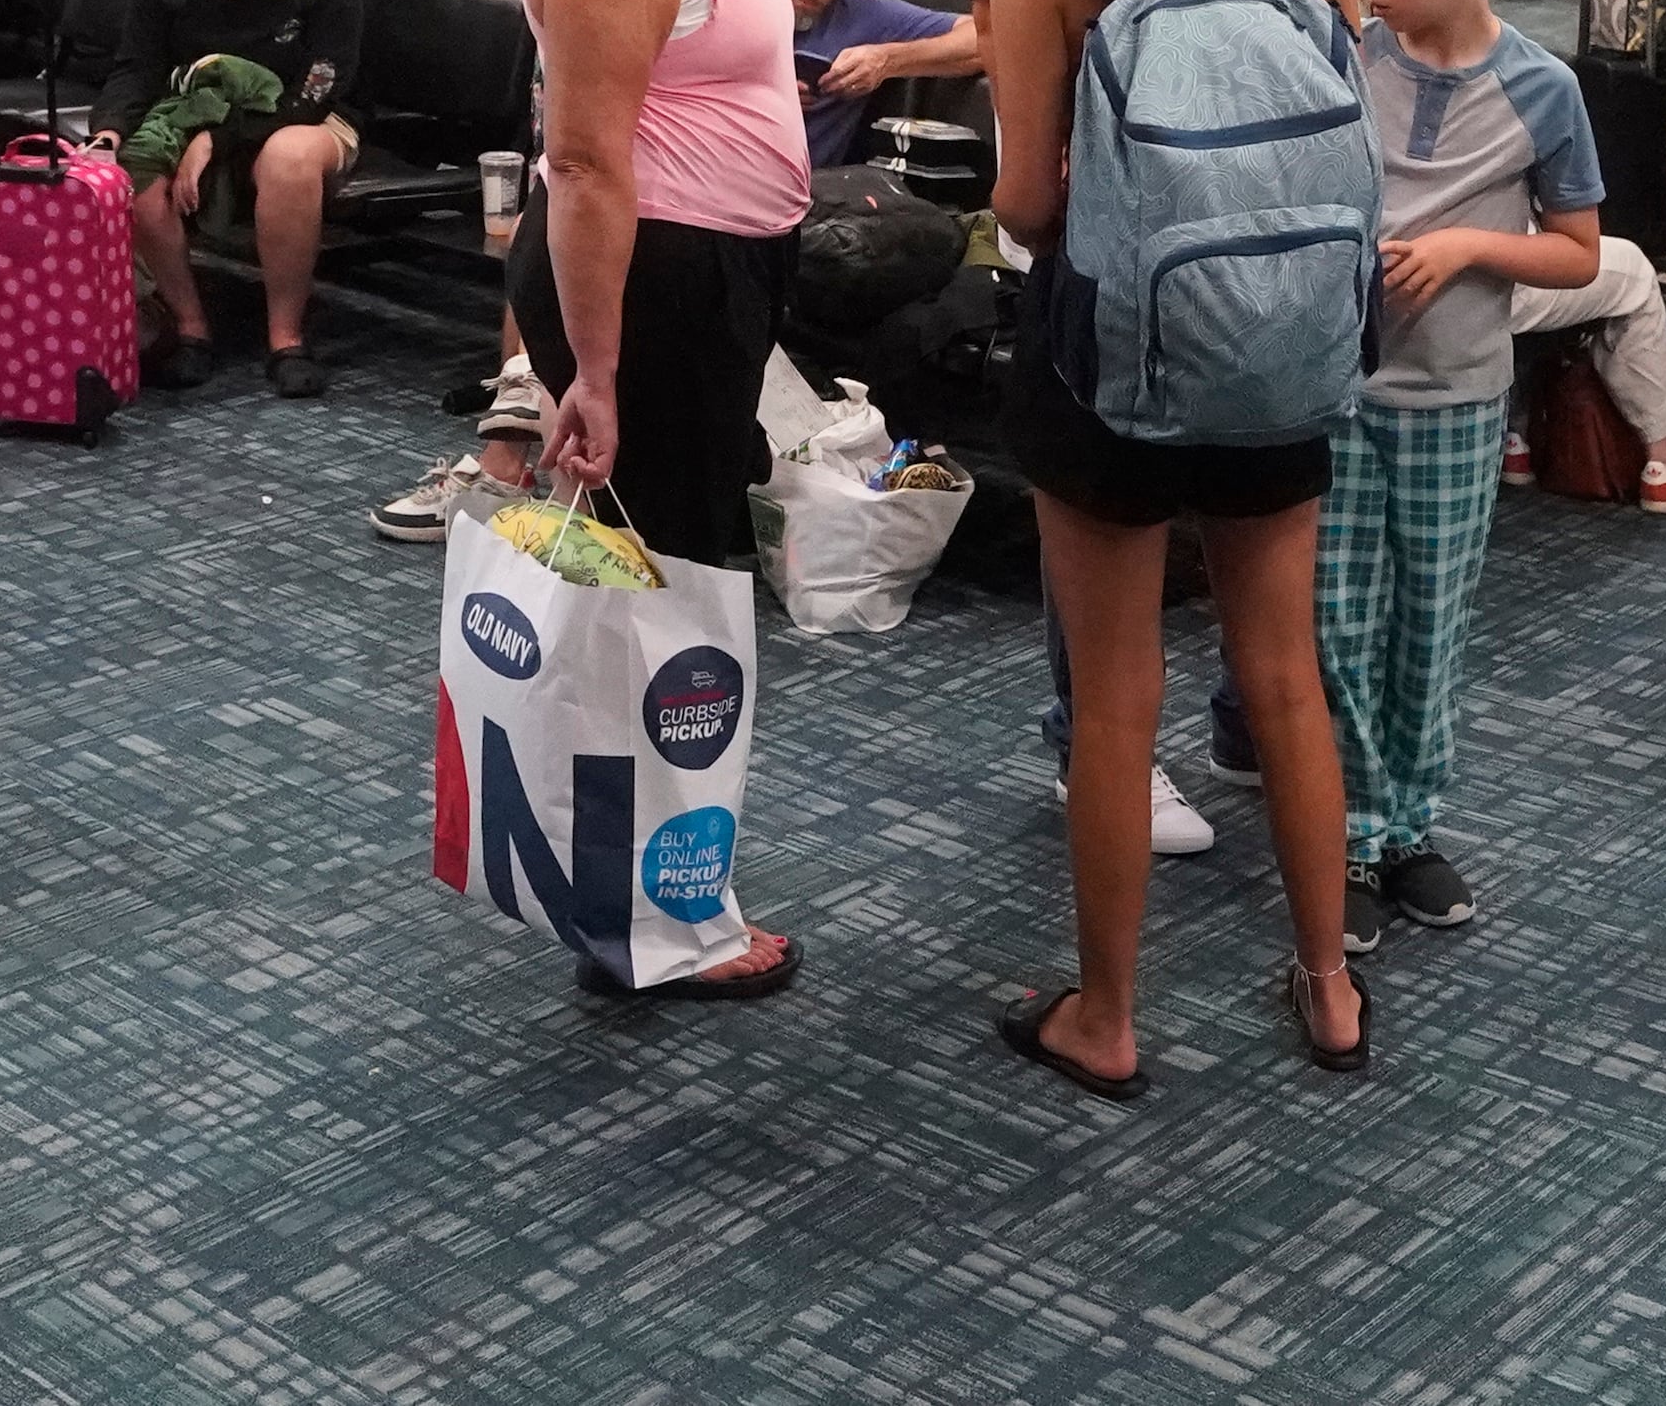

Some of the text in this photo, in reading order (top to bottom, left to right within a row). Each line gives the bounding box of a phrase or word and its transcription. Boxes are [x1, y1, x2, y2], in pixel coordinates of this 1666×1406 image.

[466, 602, 533, 669] OLD NAVY
[659, 695, 738, 726] CURBSIDE
[659, 830, 697, 848] BUY
[658, 843, 723, 866] ONLINE
[658, 862, 723, 884] PICKUP
